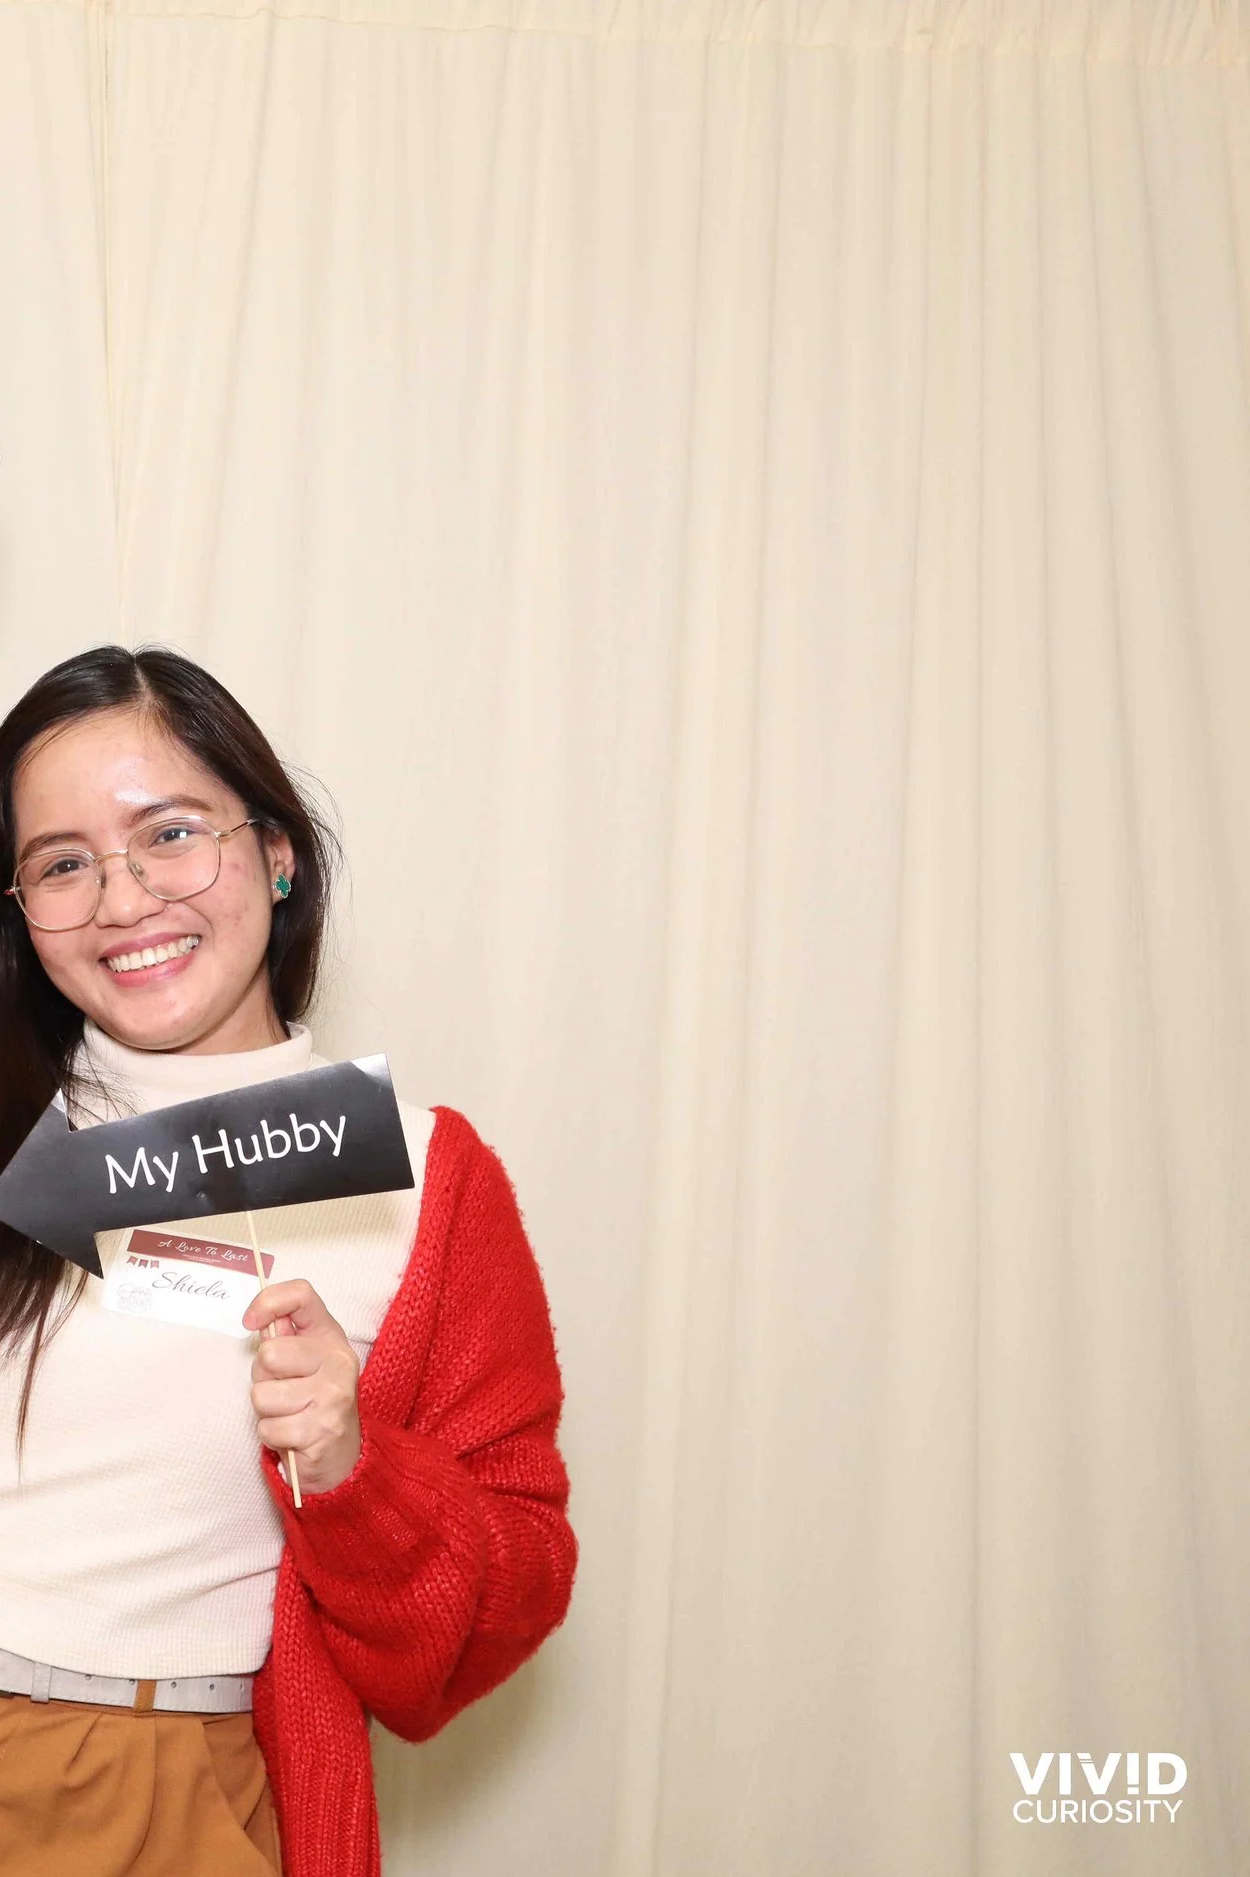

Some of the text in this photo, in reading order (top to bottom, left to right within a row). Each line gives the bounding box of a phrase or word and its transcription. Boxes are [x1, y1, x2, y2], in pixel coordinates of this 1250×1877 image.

[104, 1113, 347, 1195] My Hubby
[157, 1239, 172, 1248] A
[175, 1242, 202, 1253] Love
[205, 1245, 217, 1256] To
[221, 1249, 248, 1262] Last
[151, 1271, 231, 1300] Shiela
